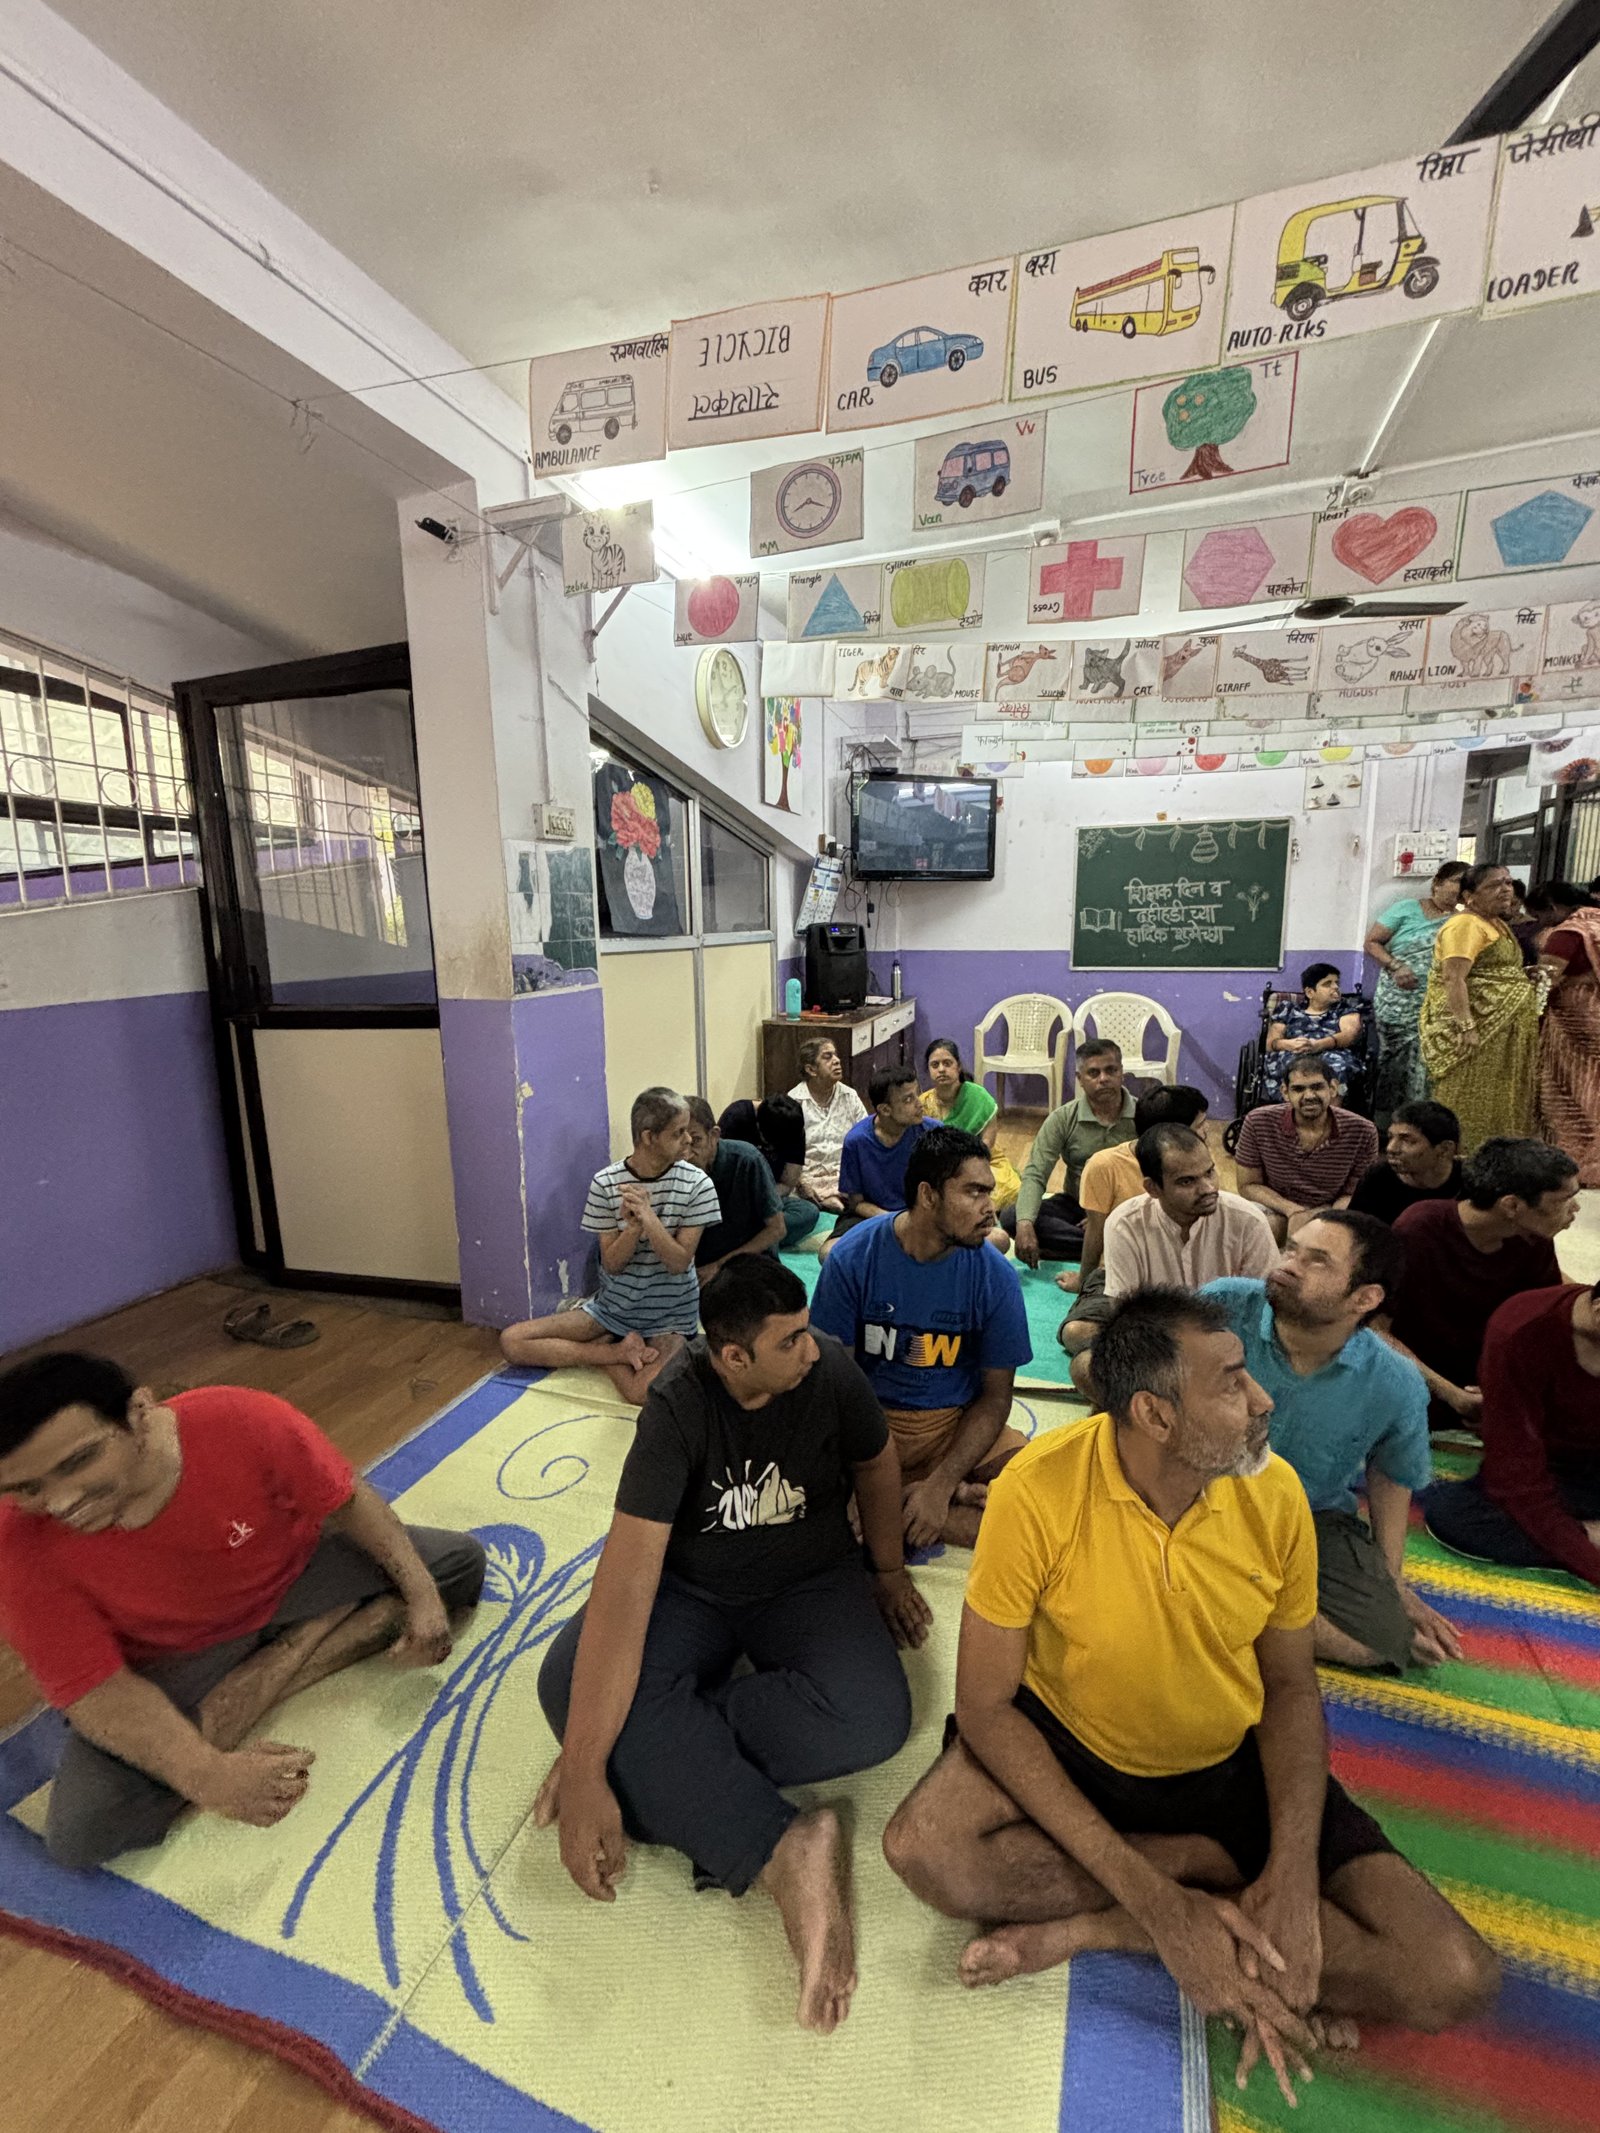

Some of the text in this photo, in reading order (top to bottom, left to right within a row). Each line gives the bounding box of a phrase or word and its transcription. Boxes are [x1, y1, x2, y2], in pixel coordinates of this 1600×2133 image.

[968, 269, 1009, 296] कार
[1486, 260, 1580, 303] LOADER
[699, 325, 791, 367] BICYCLE
[1023, 365, 1057, 389] BUS
[1259, 360, 1282, 378] Tt
[837, 387, 874, 410] CAR
[534, 445, 602, 469] AMBULANCE
[1134, 469, 1166, 488] Tree
[918, 512, 943, 527] Van
[1318, 507, 1350, 524] Heart
[885, 558, 918, 574] Cylinder
[790, 572, 822, 588] Triangle
[1033, 602, 1060, 614] Cross
[1427, 665, 1456, 677] LION
[954, 688, 981, 699] MOUSE
[1133, 685, 1153, 696] CAT
[1174, 876, 1206, 898] दिन
